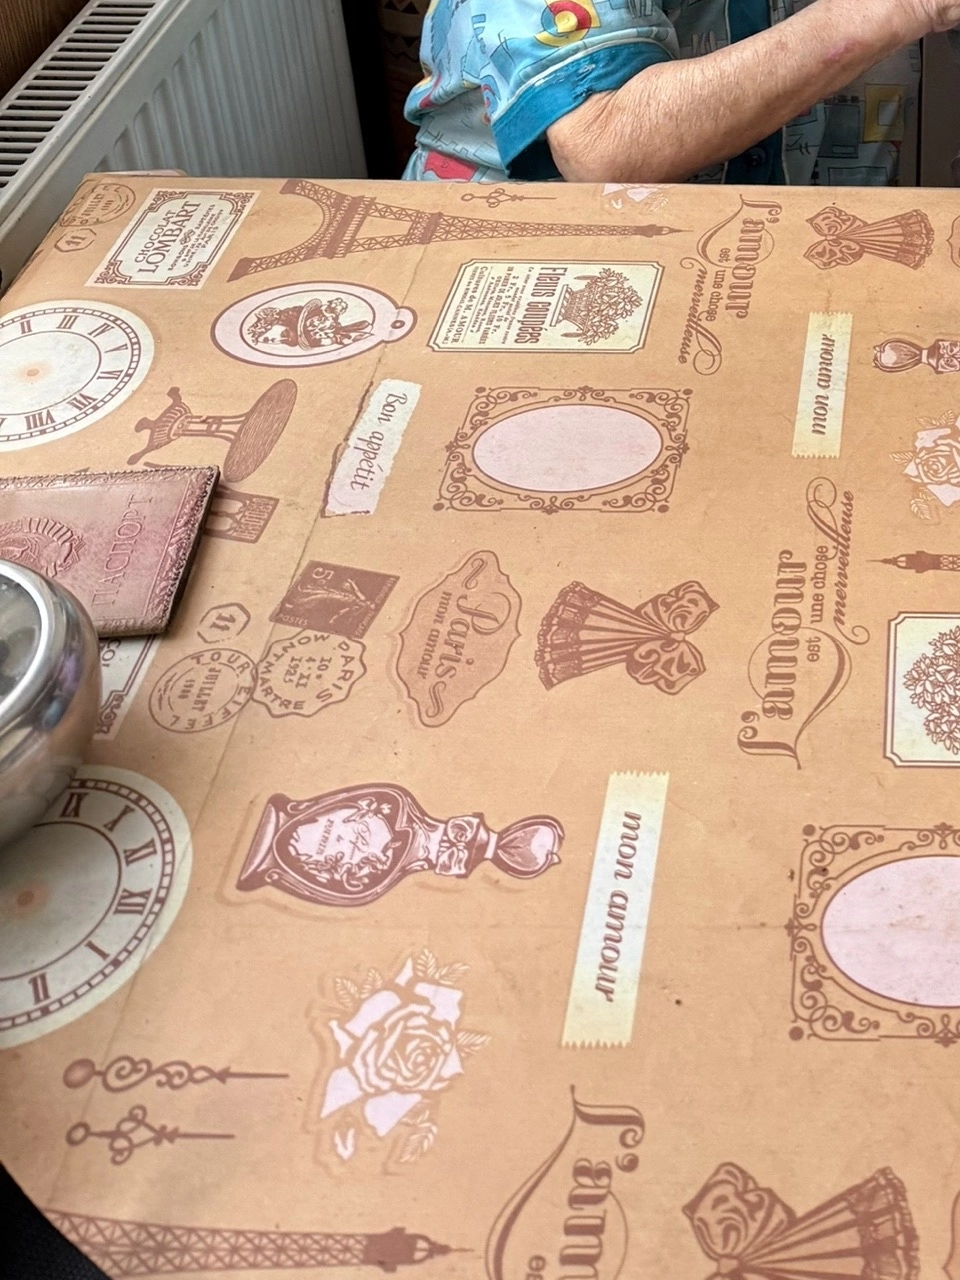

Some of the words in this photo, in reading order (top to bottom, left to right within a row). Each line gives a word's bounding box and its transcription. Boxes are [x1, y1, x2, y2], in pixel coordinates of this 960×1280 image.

[134, 210, 176, 264] CHOCOLAT
[137, 201, 201, 274] LOMBART
[718, 247, 731, 263] est
[531, 267, 568, 298] Fleurs
[712, 269, 726, 289] une
[450, 316, 468, 344] AMOUR
[514, 301, 552, 344] coupées
[816, 332, 836, 388] amour
[376, 392, 409, 425] Bon
[811, 390, 829, 436] mon
[351, 429, 386, 493] appétit
[91, 494, 154, 607] ПАСПОРТ
[810, 545, 829, 590] chose
[432, 591, 453, 627] mon
[811, 592, 825, 624] une
[416, 629, 443, 680] amour
[435, 591, 512, 680] Paris
[807, 636, 822, 662] est
[191, 651, 250, 675] TOUR
[257, 633, 330, 711] MONTMARTRE
[315, 641, 355, 703] PARIS
[169, 685, 251, 731] EIFFEL
[613, 810, 643, 882] mon
[595, 890, 630, 1003] amour
